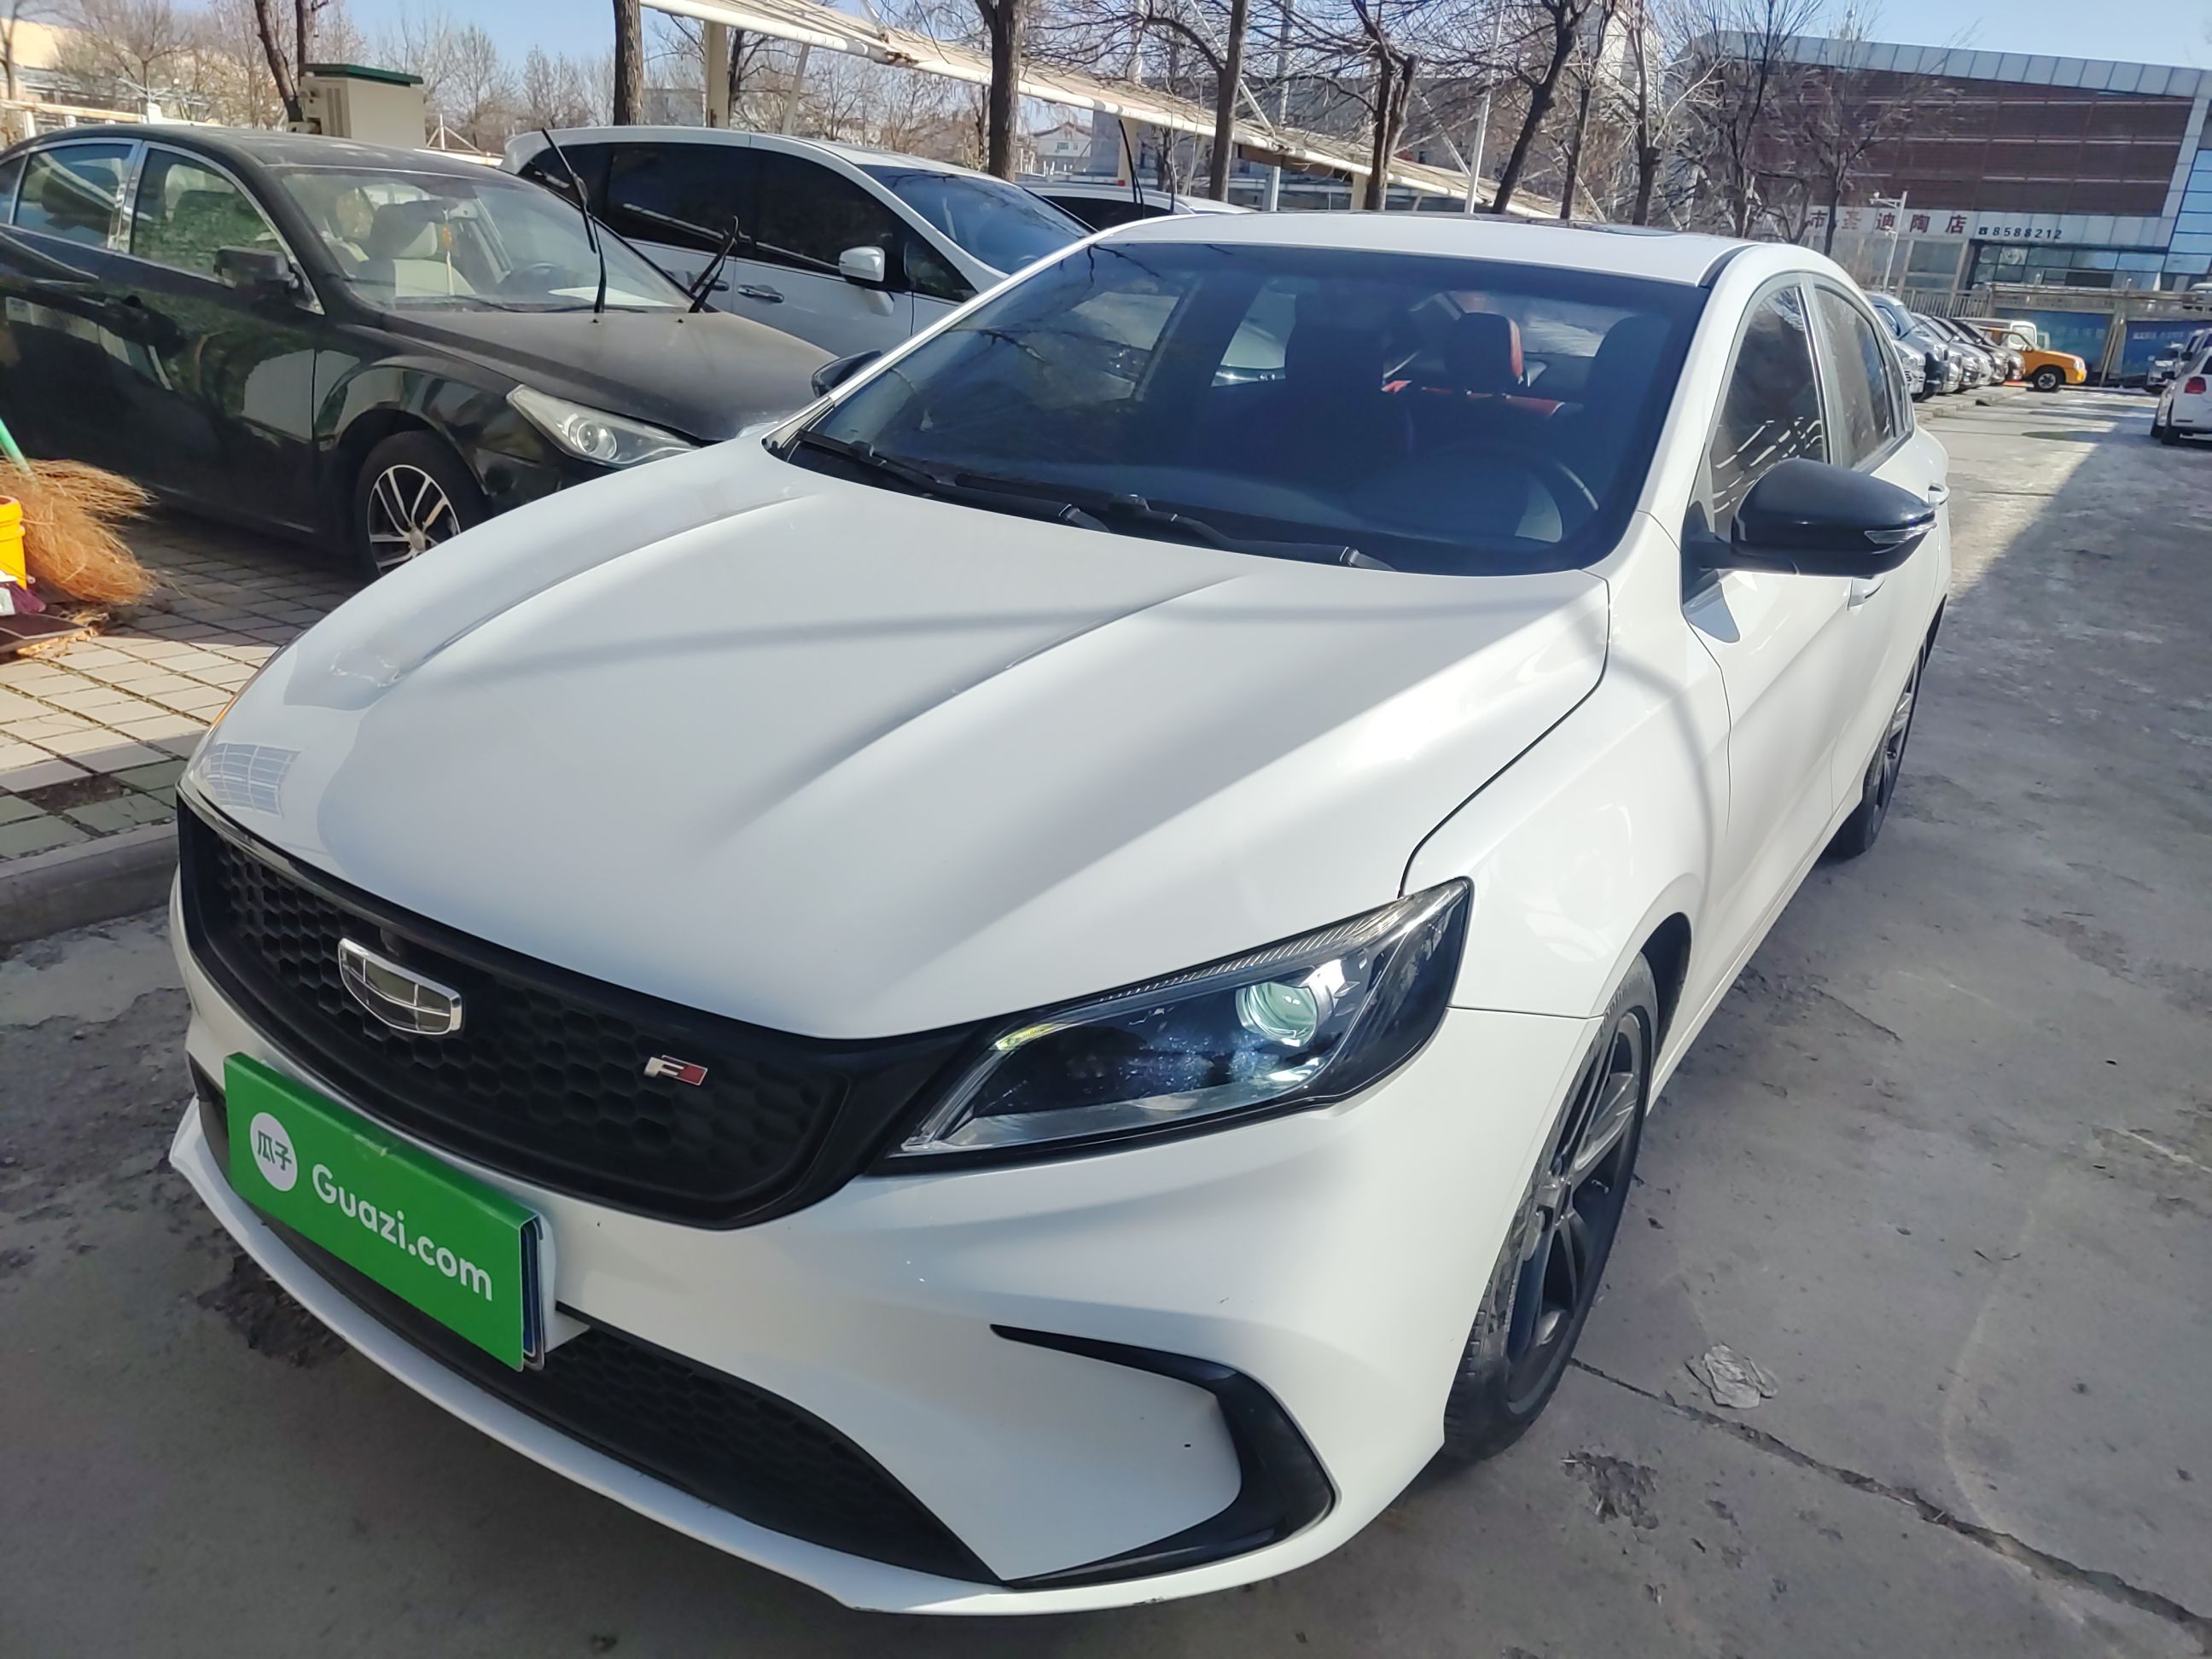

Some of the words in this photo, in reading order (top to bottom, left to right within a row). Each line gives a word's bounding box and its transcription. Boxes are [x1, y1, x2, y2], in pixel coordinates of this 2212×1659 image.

[1993, 227, 2064, 240] 8588212
[257, 1132, 292, 1171] 瓜子
[312, 1163, 492, 1301] Guazi.com
